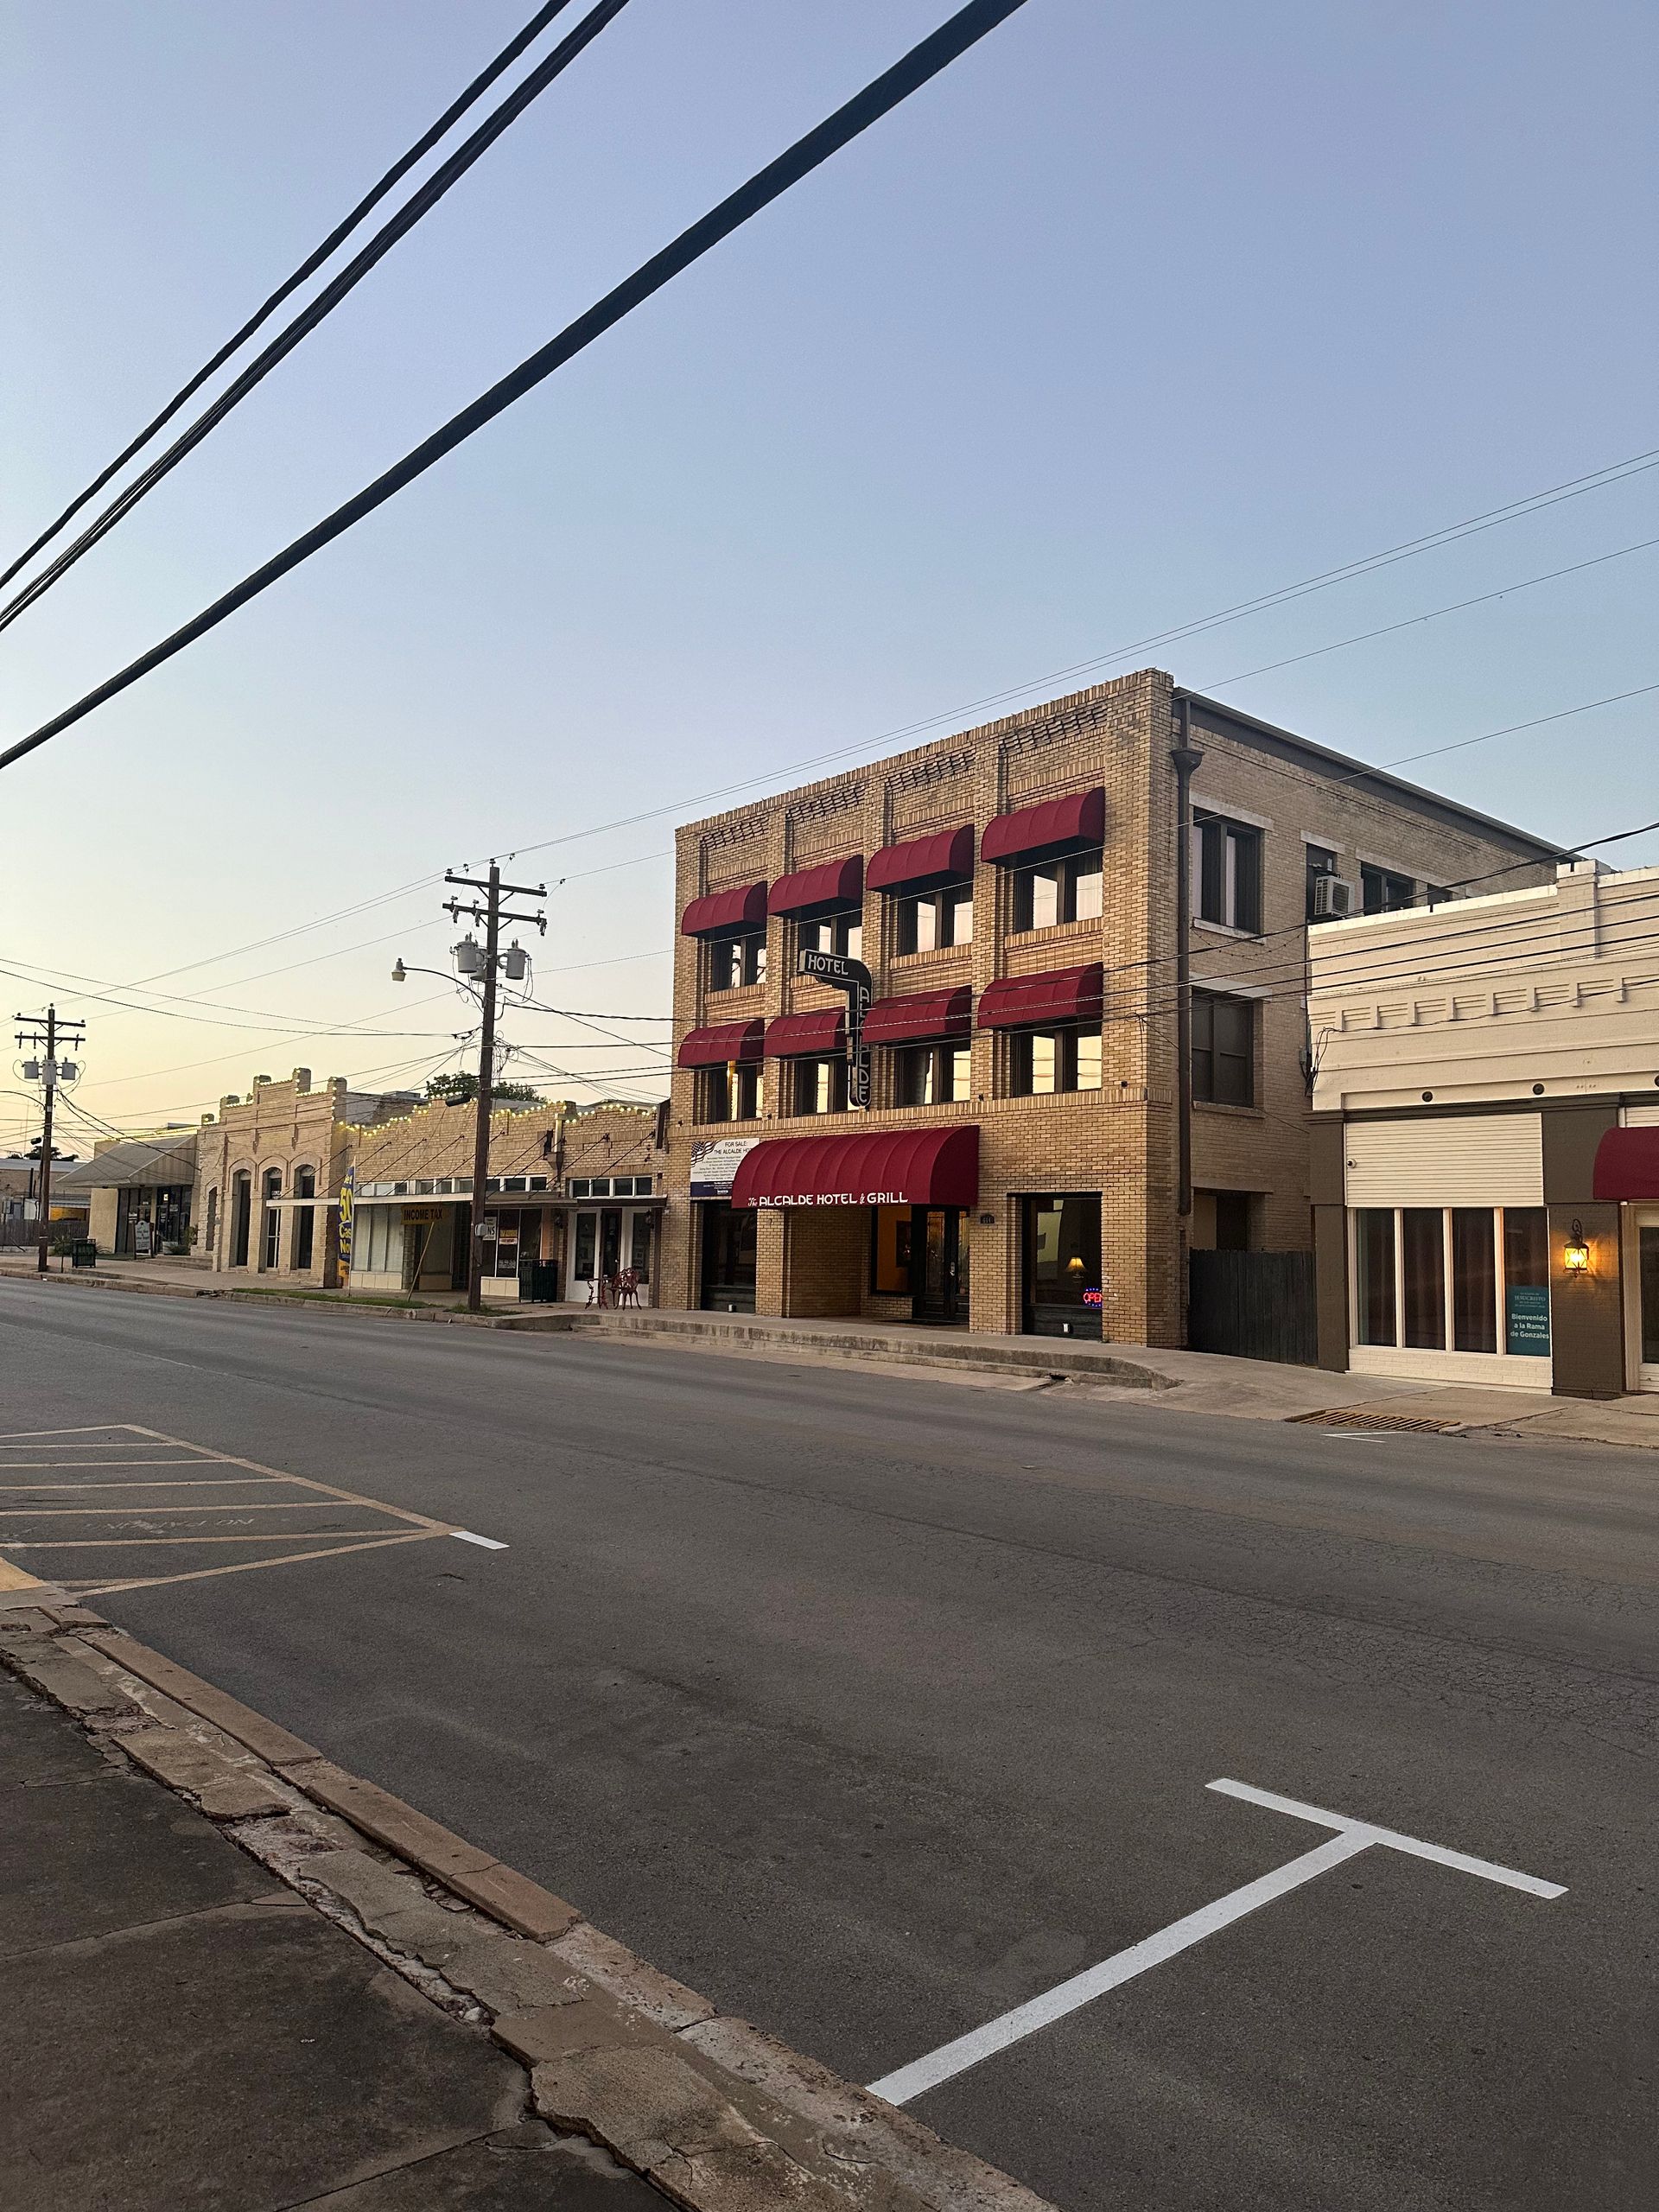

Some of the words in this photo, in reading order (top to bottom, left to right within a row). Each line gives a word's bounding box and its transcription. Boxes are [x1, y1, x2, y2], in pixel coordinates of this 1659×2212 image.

[808, 954, 849, 976] HOTEL
[747, 1197, 758, 1207] The
[759, 1194, 813, 1206] ALCALDE
[817, 1193, 857, 1205] HOTEL
[867, 1192, 908, 1204] GRILL
[404, 1209, 429, 1221] INCOME
[429, 1209, 443, 1219] TAX
[339, 1224, 352, 1239] Cas
[1511, 1313, 1548, 1322] Bienvenido
[1519, 1331, 1549, 1339] Gonzales
